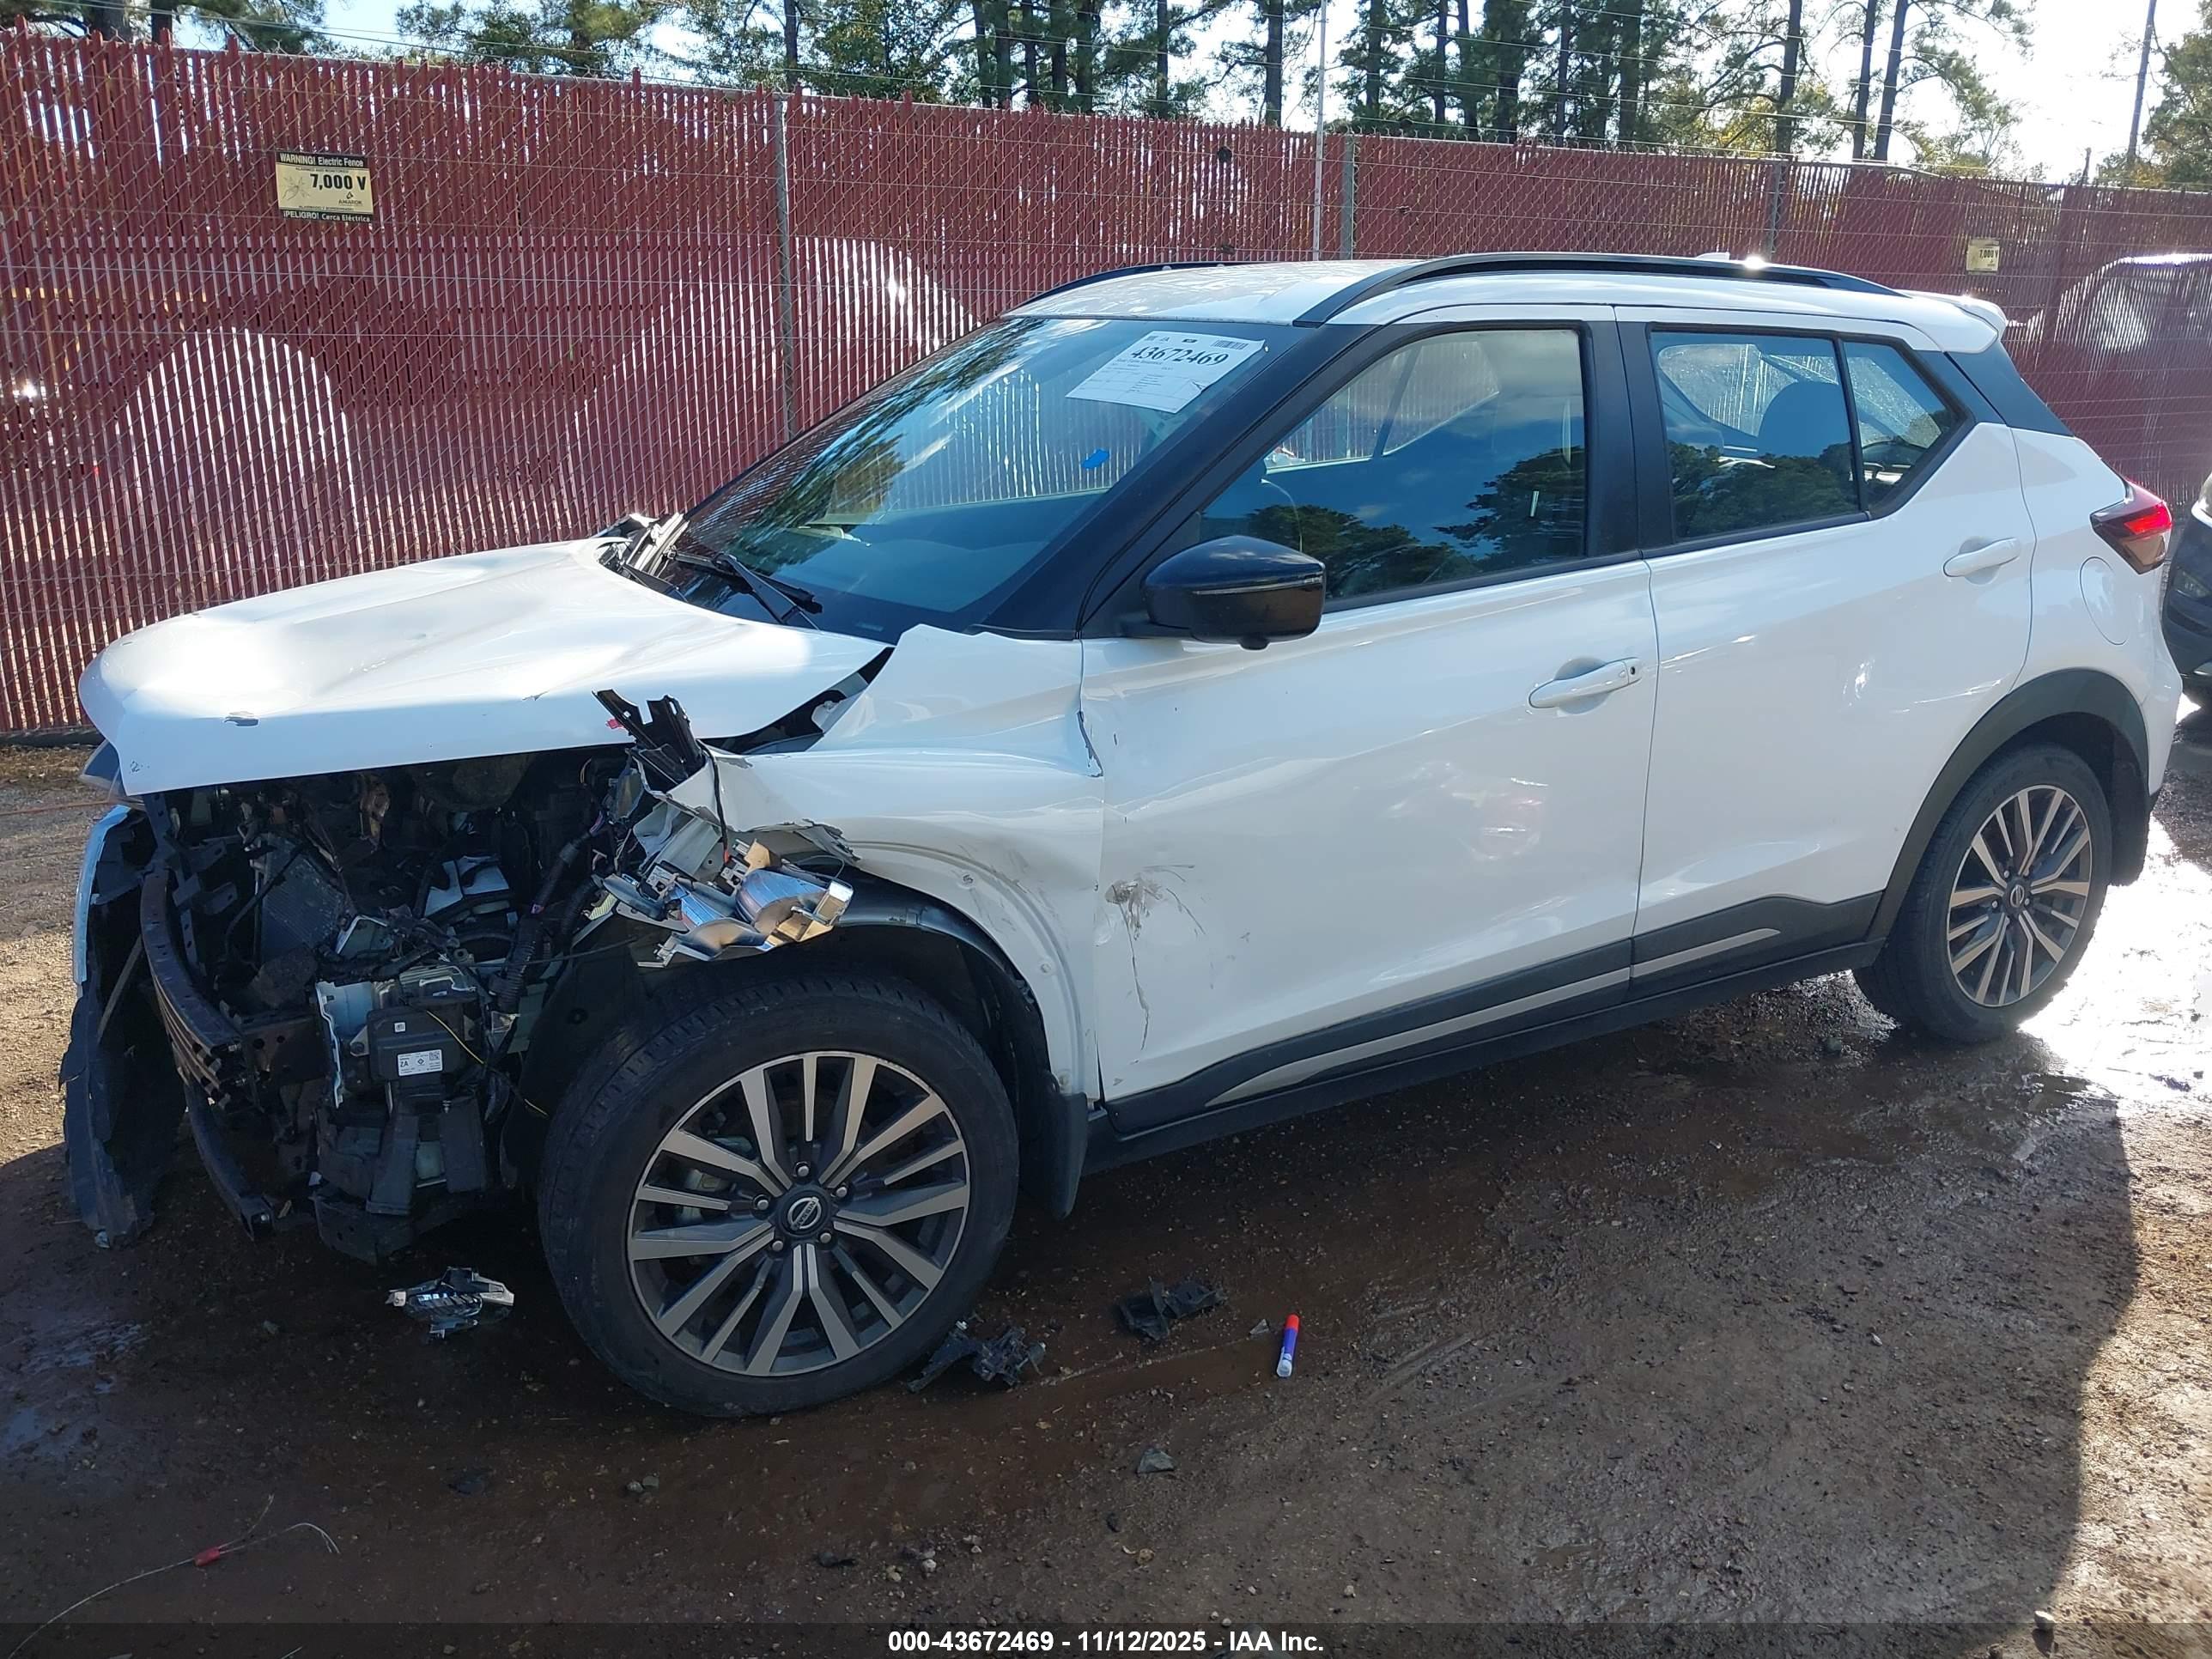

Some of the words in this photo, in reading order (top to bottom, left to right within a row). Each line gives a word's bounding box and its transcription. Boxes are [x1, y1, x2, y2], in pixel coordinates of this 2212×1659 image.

[280, 153, 316, 165] WARNING!
[318, 157, 343, 167] Electric
[343, 158, 364, 167] Fence
[310, 173, 353, 191] 7,000
[356, 176, 367, 191] V
[283, 210, 319, 220] ¡PELIGRO!
[1979, 249, 1994, 258] 7,000
[1132, 346, 1229, 366] 43672469
